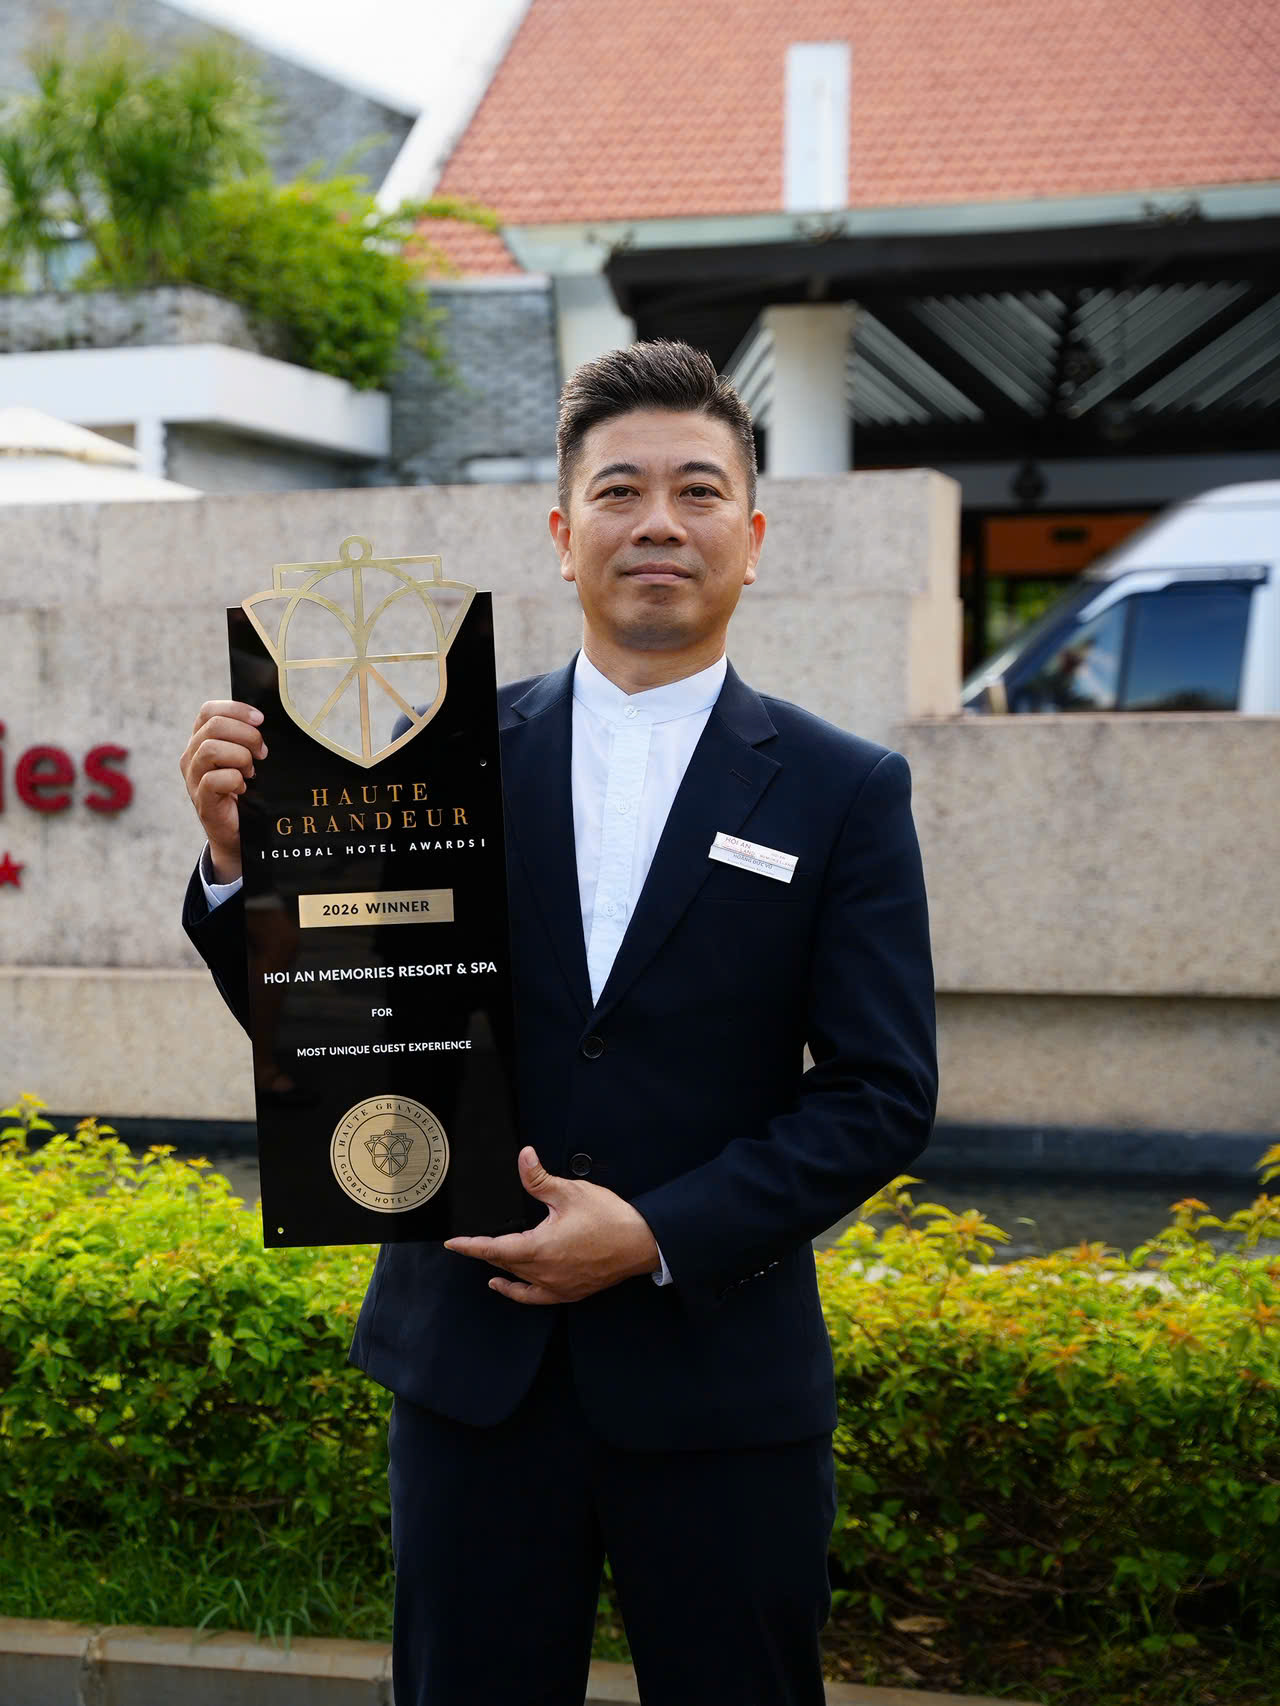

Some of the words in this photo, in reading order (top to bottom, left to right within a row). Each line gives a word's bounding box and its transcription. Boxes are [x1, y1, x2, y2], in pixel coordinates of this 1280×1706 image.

[311, 782, 429, 808] HAUTE
[276, 806, 470, 836] GRANDEUR
[271, 846, 333, 859] GLOBAL
[345, 843, 397, 855] HOTEL
[409, 838, 475, 853] AWARDS
[322, 903, 359, 916] 2026
[365, 900, 431, 914] WINNER
[263, 971, 290, 985] HOI
[293, 970, 315, 983] AN
[318, 966, 395, 982] MEMORIES
[398, 963, 453, 978] RESORT
[456, 962, 468, 975] &
[470, 960, 498, 974] SPA
[371, 1007, 393, 1018] FOR
[296, 1046, 327, 1058] MOST
[329, 1044, 371, 1056] UNIQUE
[372, 1042, 407, 1054] GUEST
[408, 1039, 472, 1052] EXPERIENCE
[339, 1109, 368, 1147] HAUTE
[376, 1103, 439, 1142] GRANDEUR
[340, 1163, 367, 1198] GLOBAL
[375, 1196, 408, 1205] HOTEL
[415, 1158, 441, 1196] AWARDS
